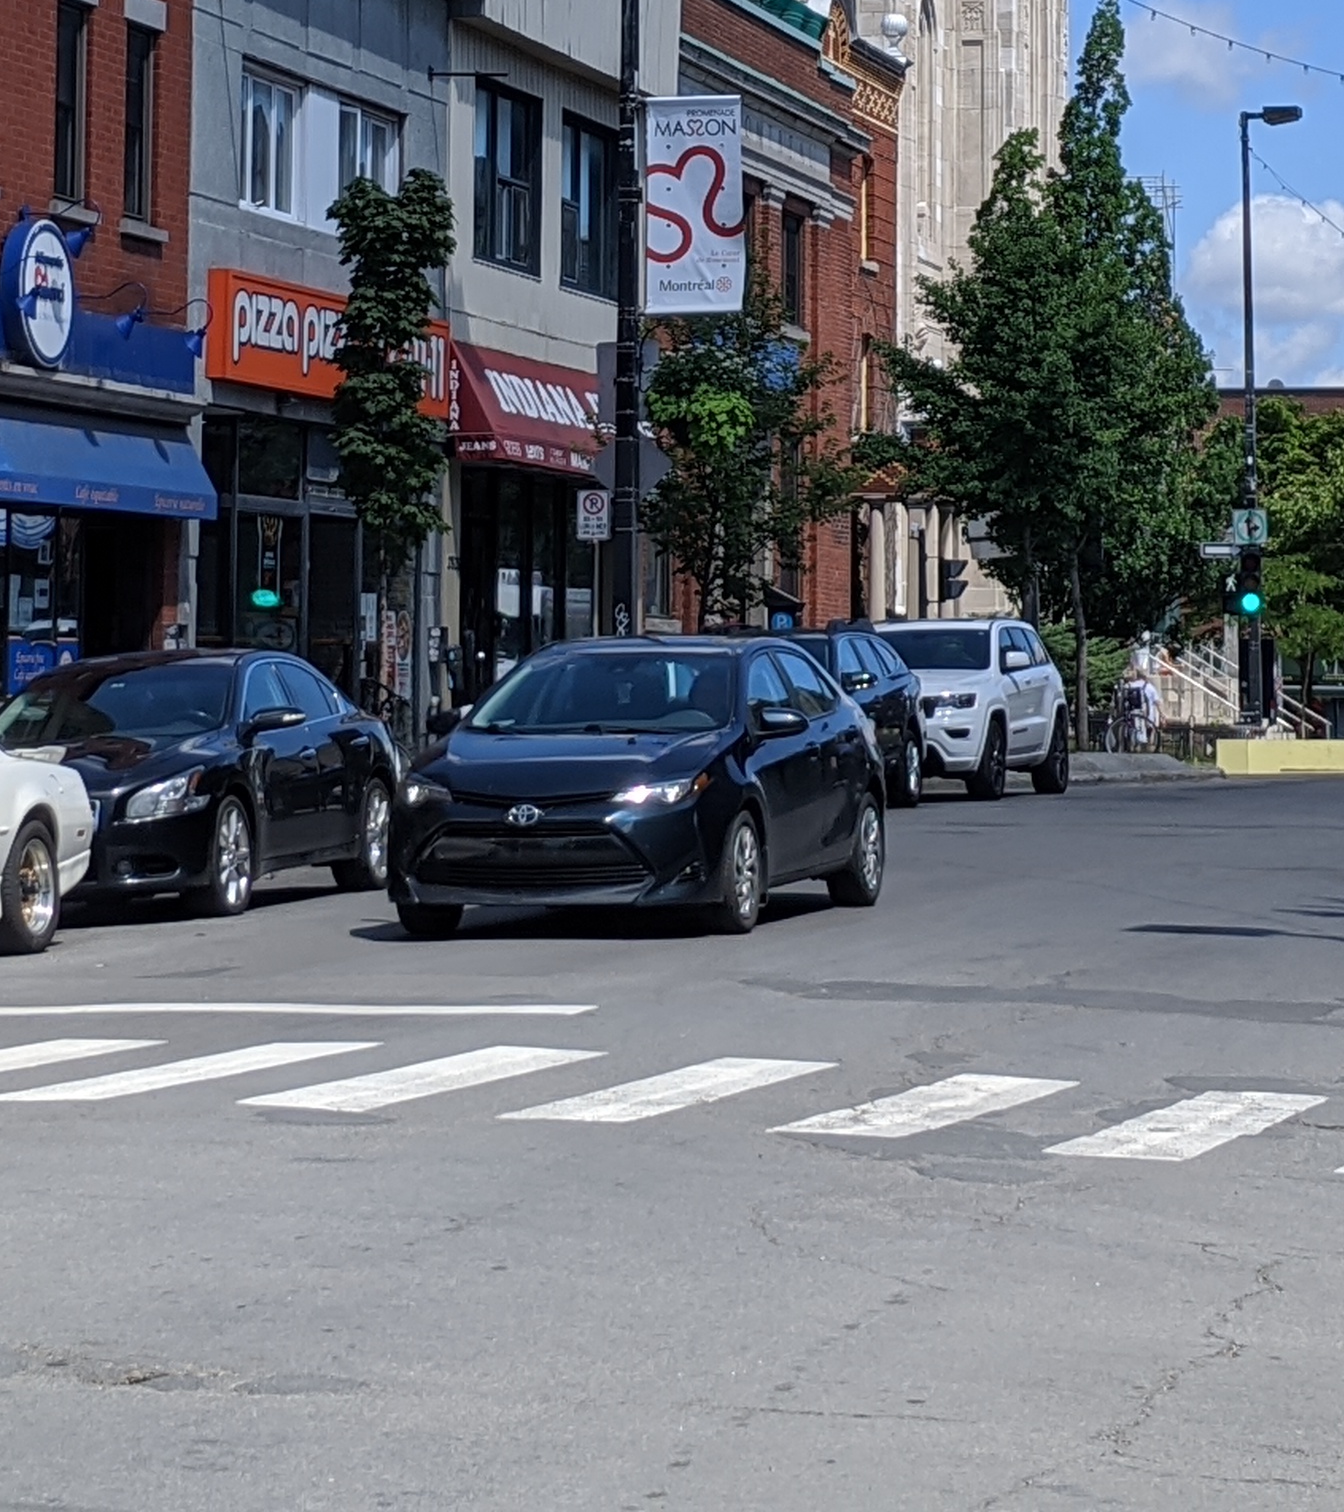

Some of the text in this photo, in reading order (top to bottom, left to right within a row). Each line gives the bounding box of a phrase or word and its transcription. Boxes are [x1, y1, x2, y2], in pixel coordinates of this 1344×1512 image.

[686, 108, 735, 118] PROMENADE
[654, 119, 737, 138] MASSON
[659, 279, 715, 292] Montréal
[449, 359, 460, 431] INDIANA
[484, 368, 595, 431] INDIANA
[459, 440, 497, 453] JEANS
